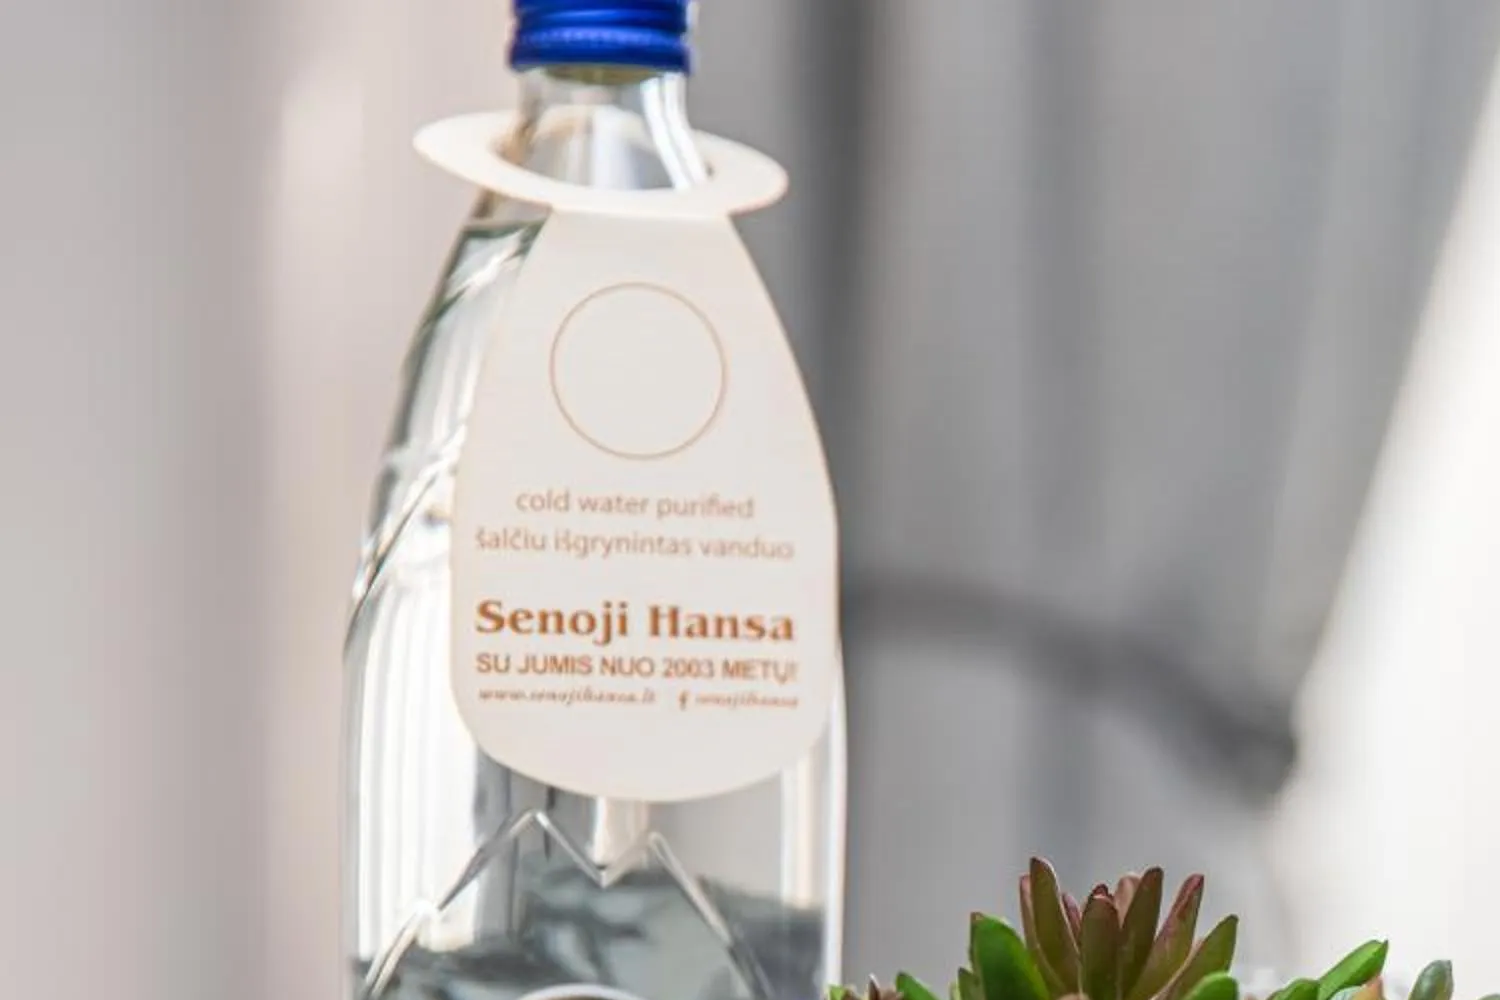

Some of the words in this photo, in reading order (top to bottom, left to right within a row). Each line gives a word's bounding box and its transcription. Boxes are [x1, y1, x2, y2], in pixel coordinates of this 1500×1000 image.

[515, 487, 570, 513] cold
[578, 494, 649, 515] water
[656, 492, 755, 520] purified
[700, 535, 795, 559] vanduo
[476, 599, 628, 647] Senoji
[648, 604, 794, 641] Hansa
[476, 653, 511, 675] SU
[516, 654, 594, 676] JUMIS
[600, 655, 656, 678] NUO
[663, 657, 715, 679] 2003
